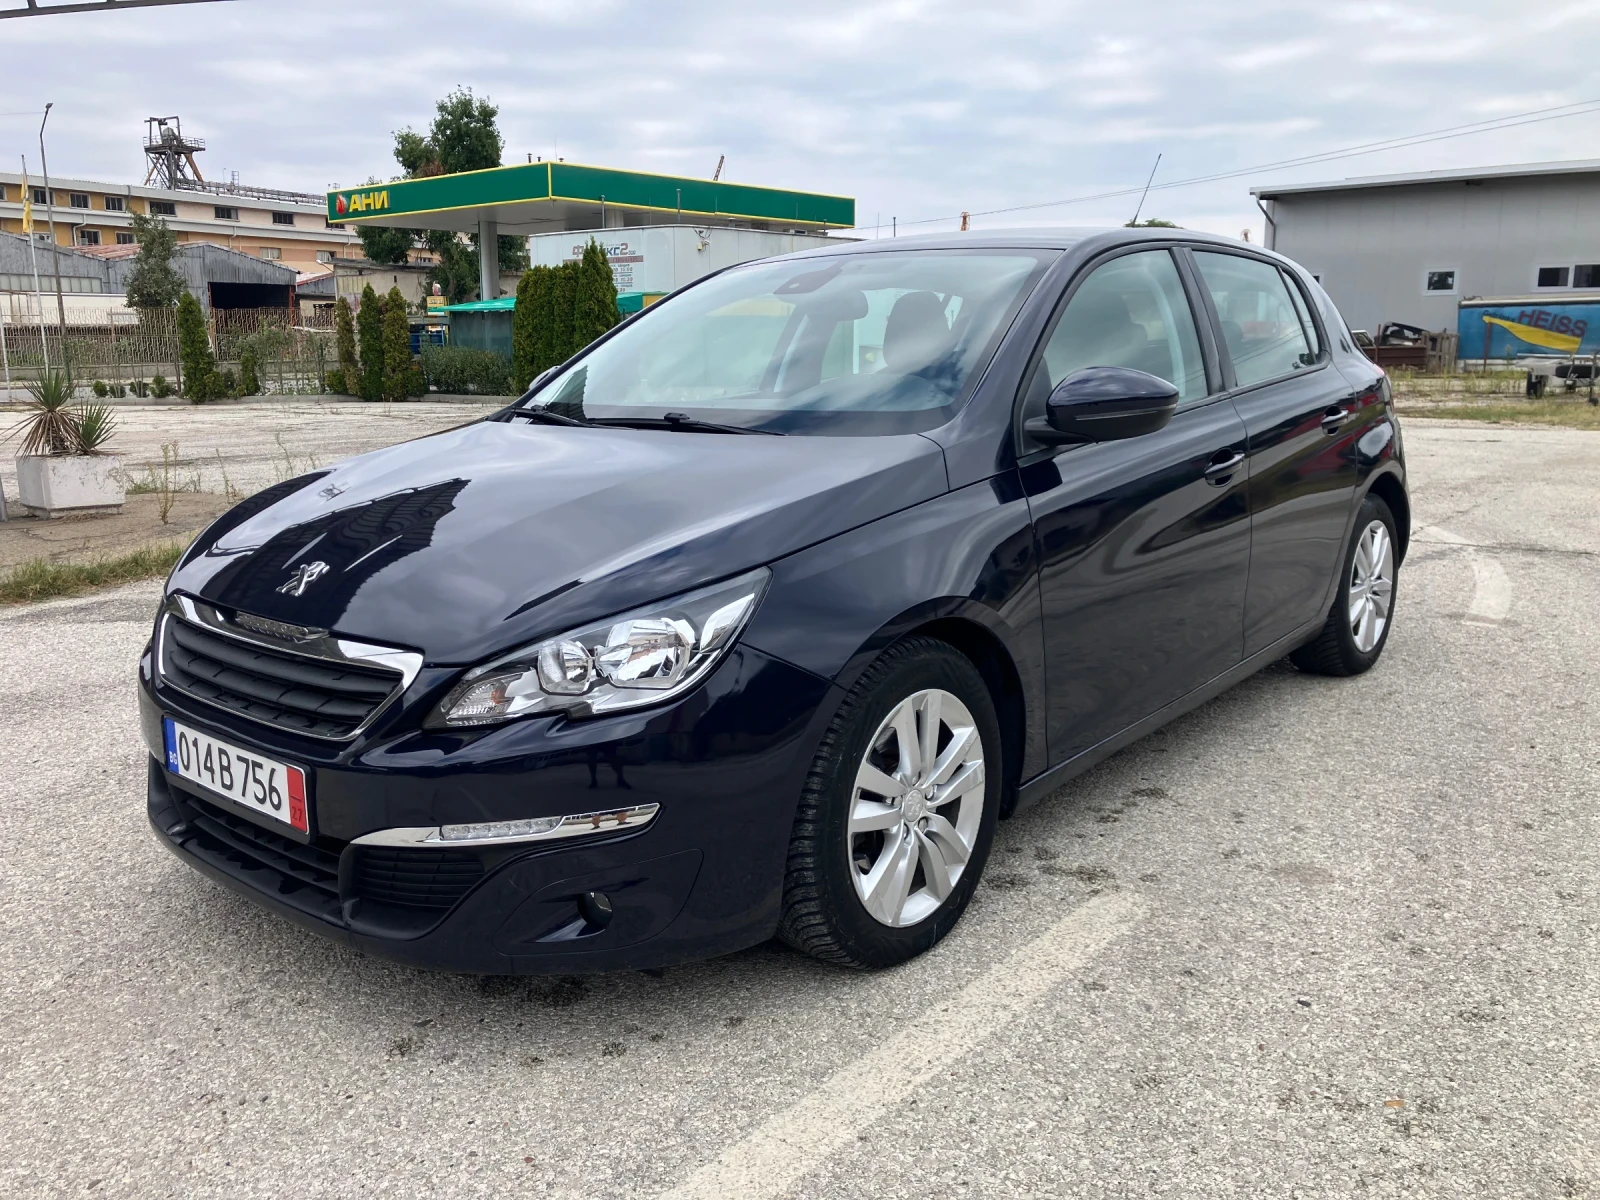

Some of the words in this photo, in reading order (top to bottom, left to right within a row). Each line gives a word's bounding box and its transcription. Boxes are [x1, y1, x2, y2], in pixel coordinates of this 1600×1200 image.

[349, 190, 388, 212] АНИ
[1517, 309, 1588, 338] HEISS
[169, 751, 178, 764] BG
[178, 731, 282, 811] 014B756
